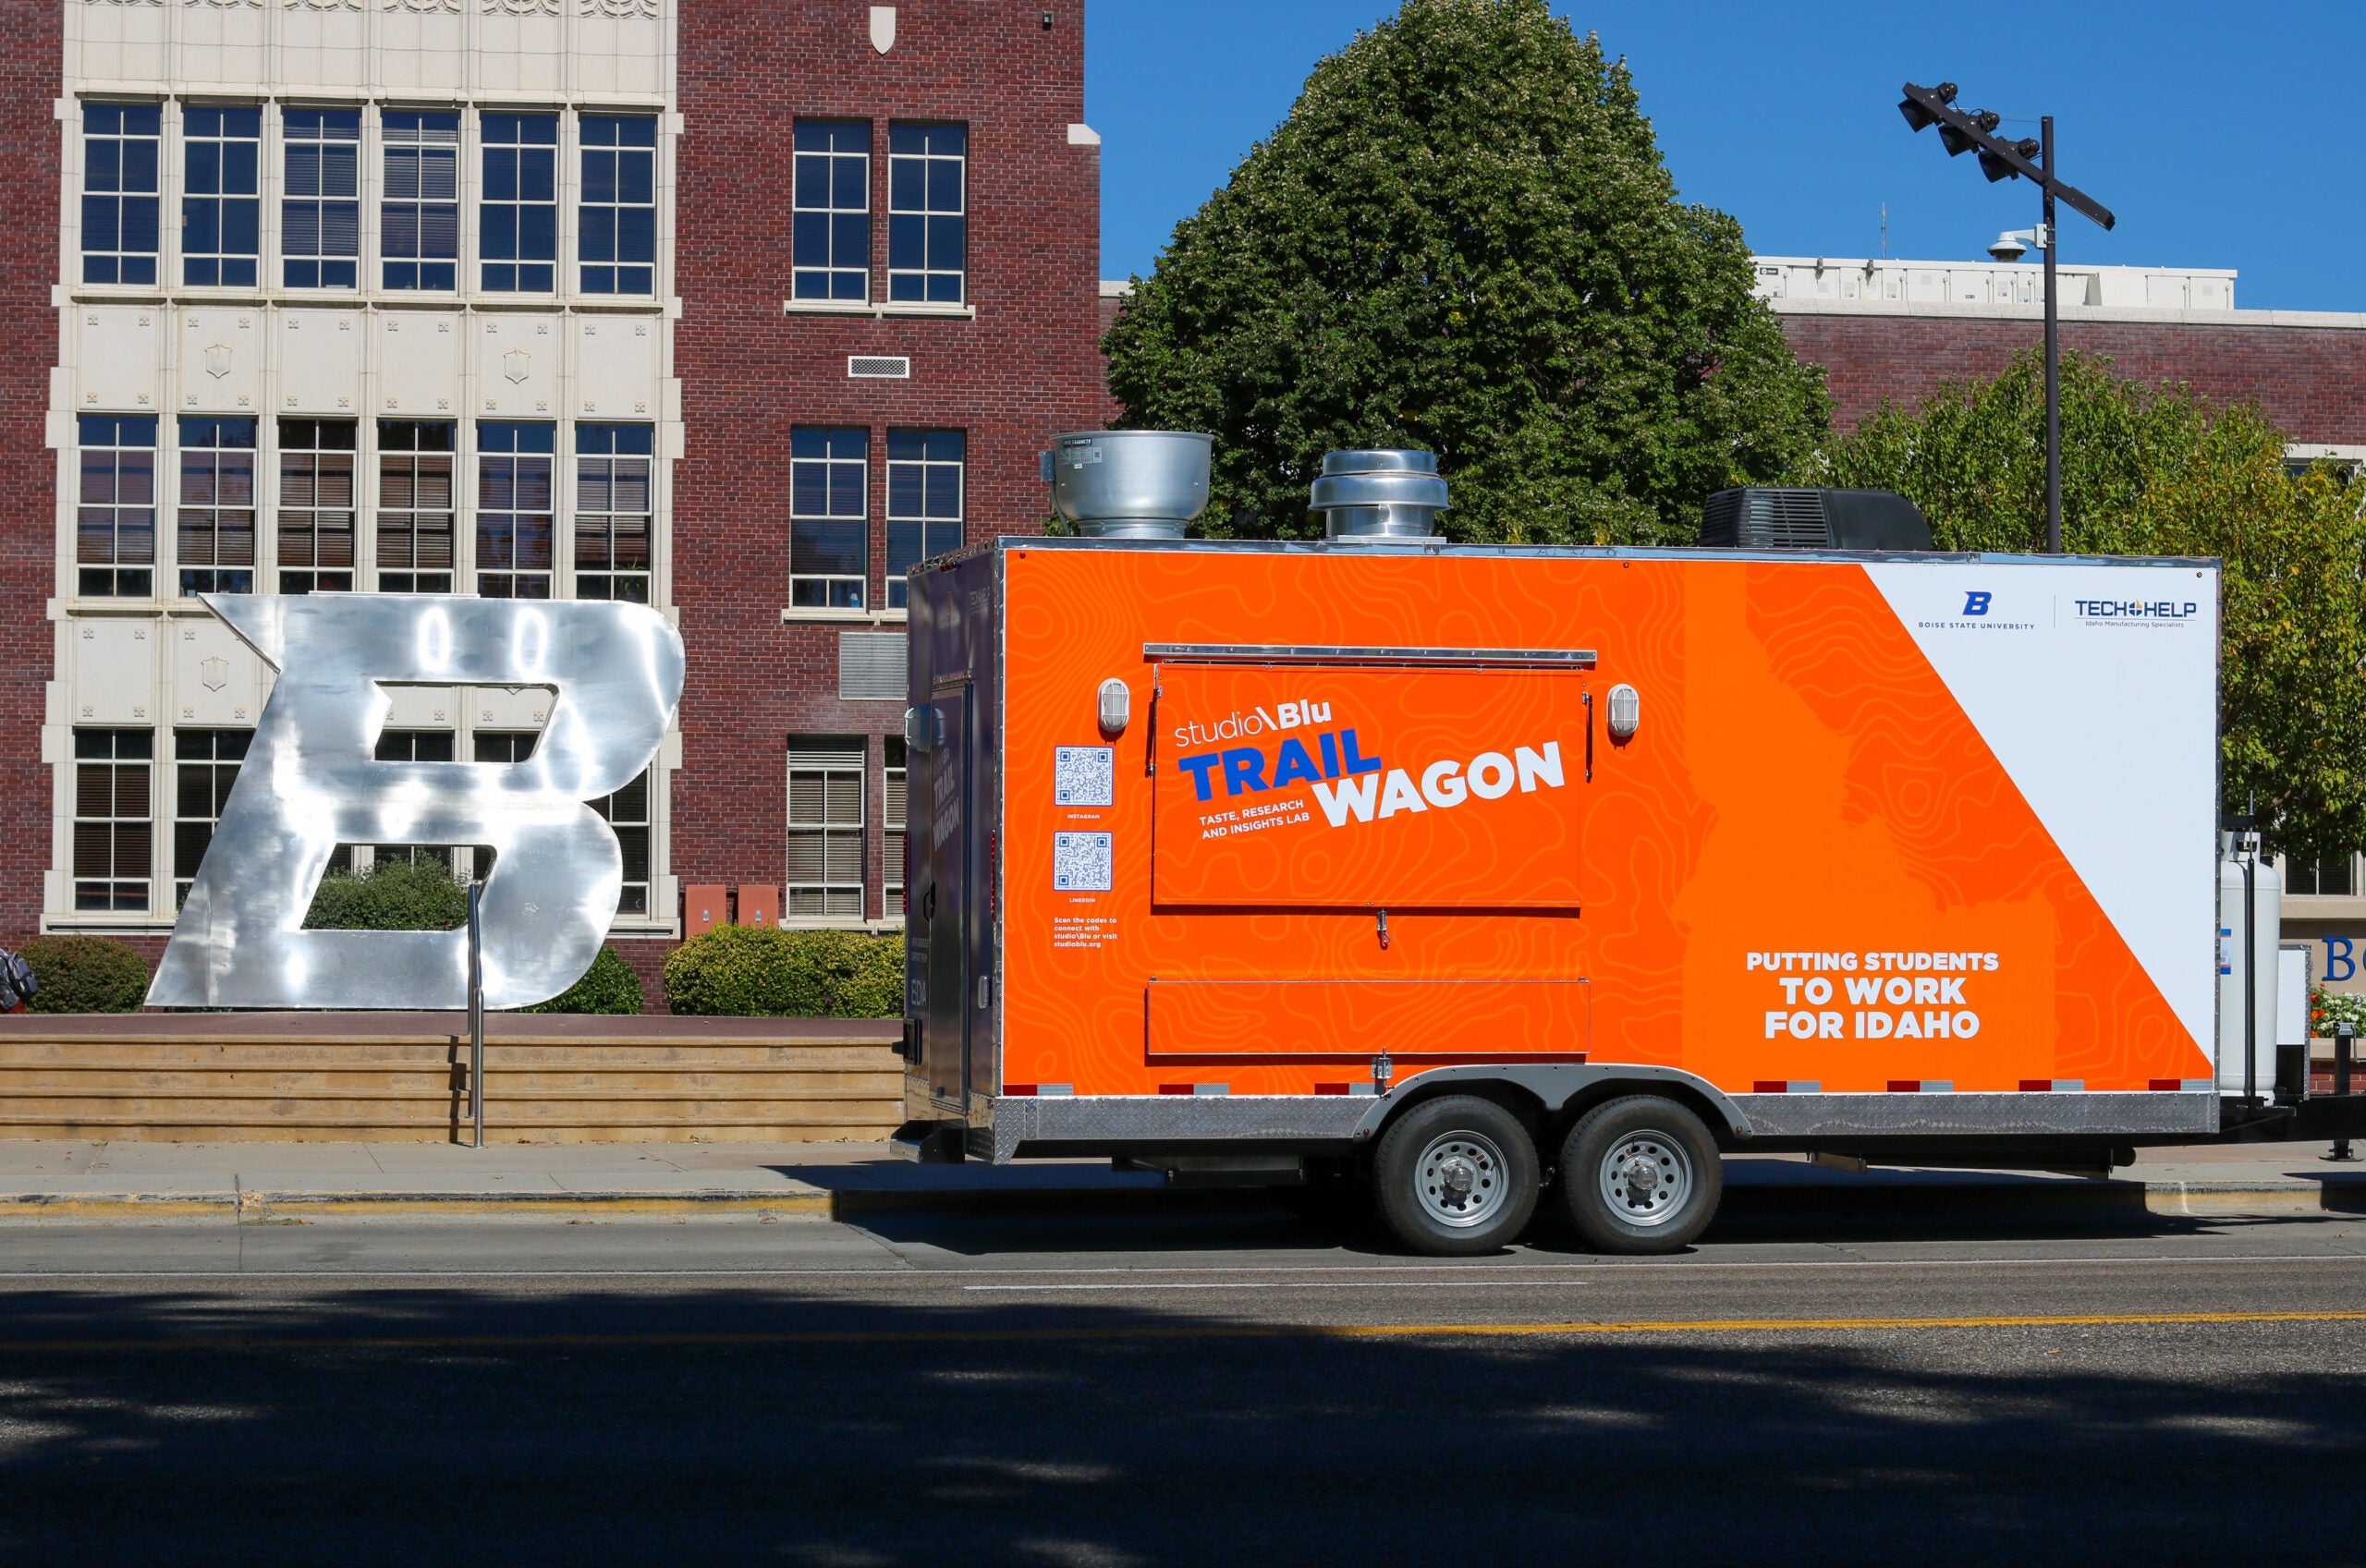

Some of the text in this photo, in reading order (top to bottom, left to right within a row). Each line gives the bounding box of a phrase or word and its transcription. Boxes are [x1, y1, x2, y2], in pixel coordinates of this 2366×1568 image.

[1962, 590, 1993, 616] B
[1918, 621, 1945, 629] BOISE
[1980, 622, 2035, 630] UNIVERSITY
[2104, 620, 2150, 629] Manufacturing
[1177, 728, 1383, 802] TRAIL
[1311, 740, 1565, 828] WAGON
[1199, 799, 1305, 826] TASTE, RESEARCH
[1201, 811, 1311, 840] AND INSIGHTS LAB
[1747, 952, 2000, 971] PUTTING STUDENTS
[2321, 936, 2366, 982] B
[1779, 977, 1968, 1005] TO WORK
[1764, 1010, 1981, 1039] FOR IDAHO
